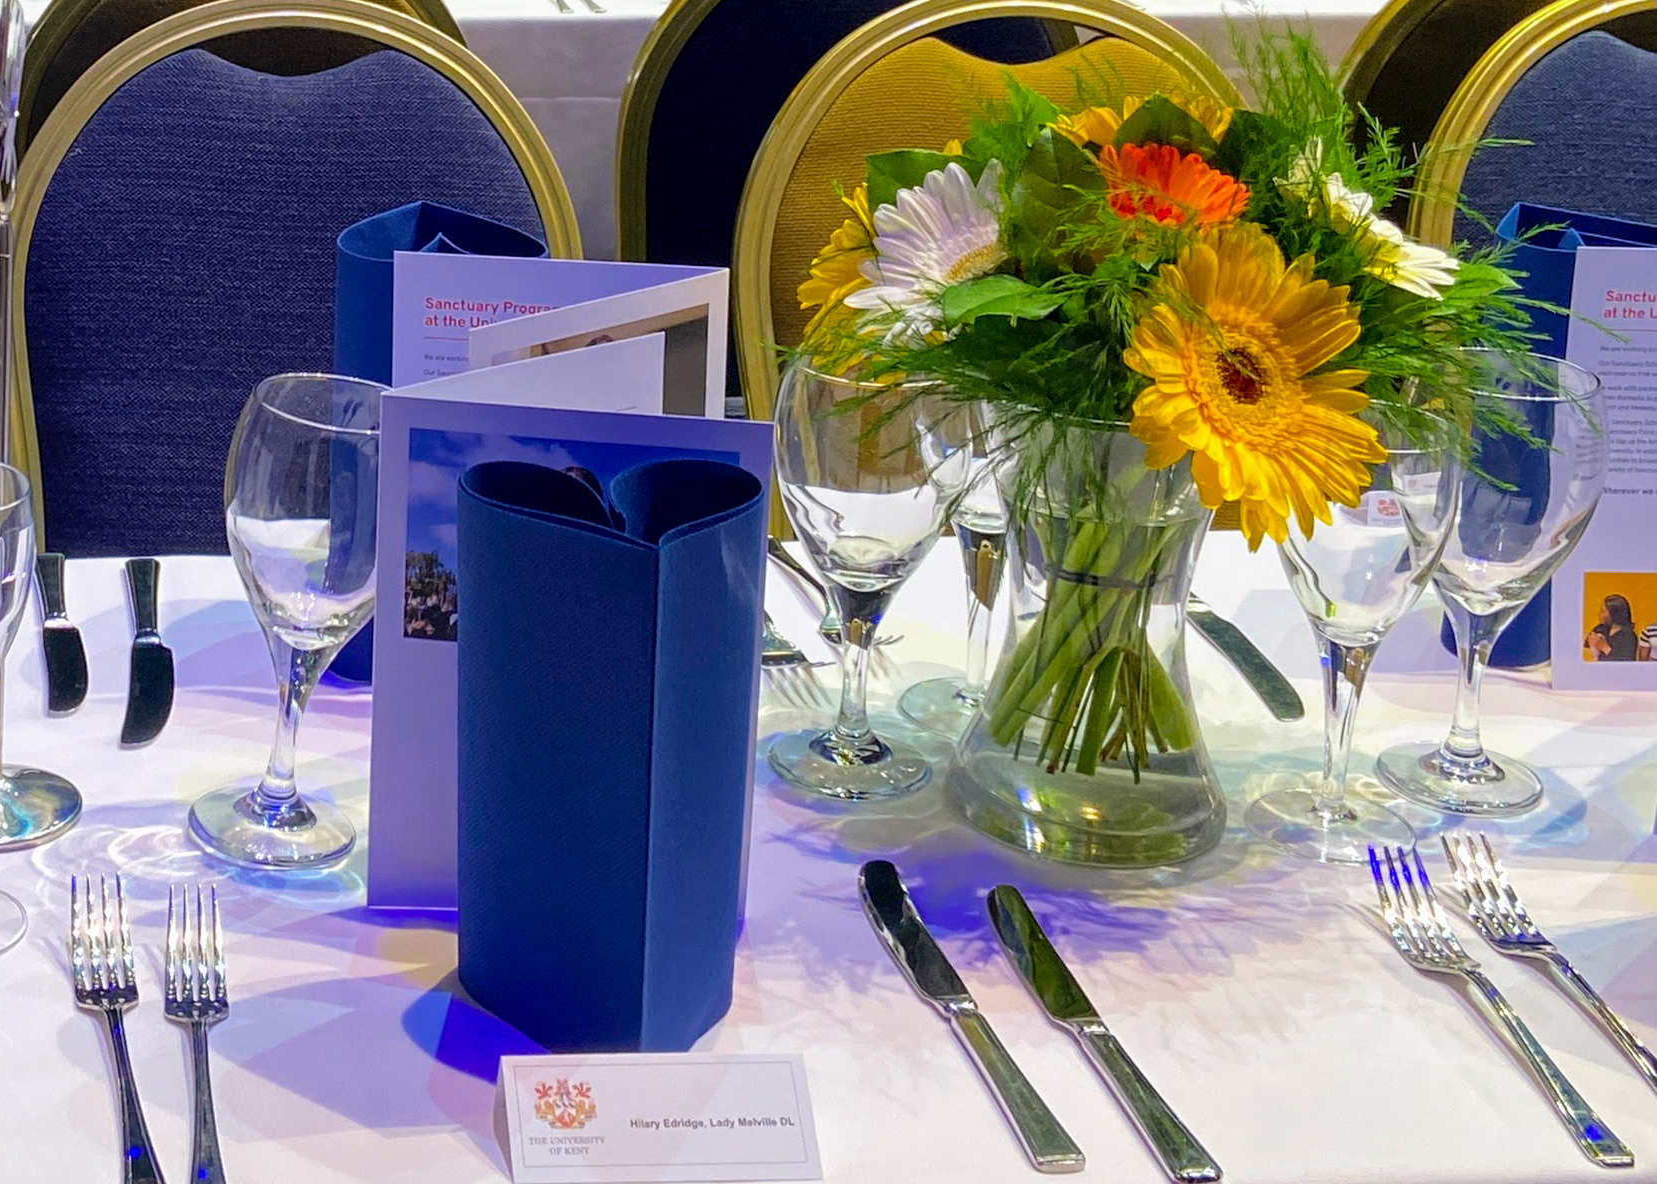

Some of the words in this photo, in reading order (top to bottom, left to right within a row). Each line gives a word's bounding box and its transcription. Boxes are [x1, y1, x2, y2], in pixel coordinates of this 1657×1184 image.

[1605, 290, 1657, 303] Sanctu
[425, 297, 499, 315] Sanctuary
[503, 301, 559, 314] Progra
[1604, 307, 1617, 318] at
[1623, 307, 1645, 318] the
[425, 315, 439, 326] at
[443, 315, 465, 327] the
[630, 1119, 660, 1130] Hilary
[663, 1118, 707, 1129] Edridge,
[709, 1118, 735, 1129] Lady
[738, 1117, 777, 1126] Melville
[780, 1116, 795, 1126] DL
[529, 1137, 548, 1145] THE
[550, 1136, 605, 1145] UNIVERSITY
[549, 1147, 562, 1155] OF
[564, 1147, 589, 1155] KENT
